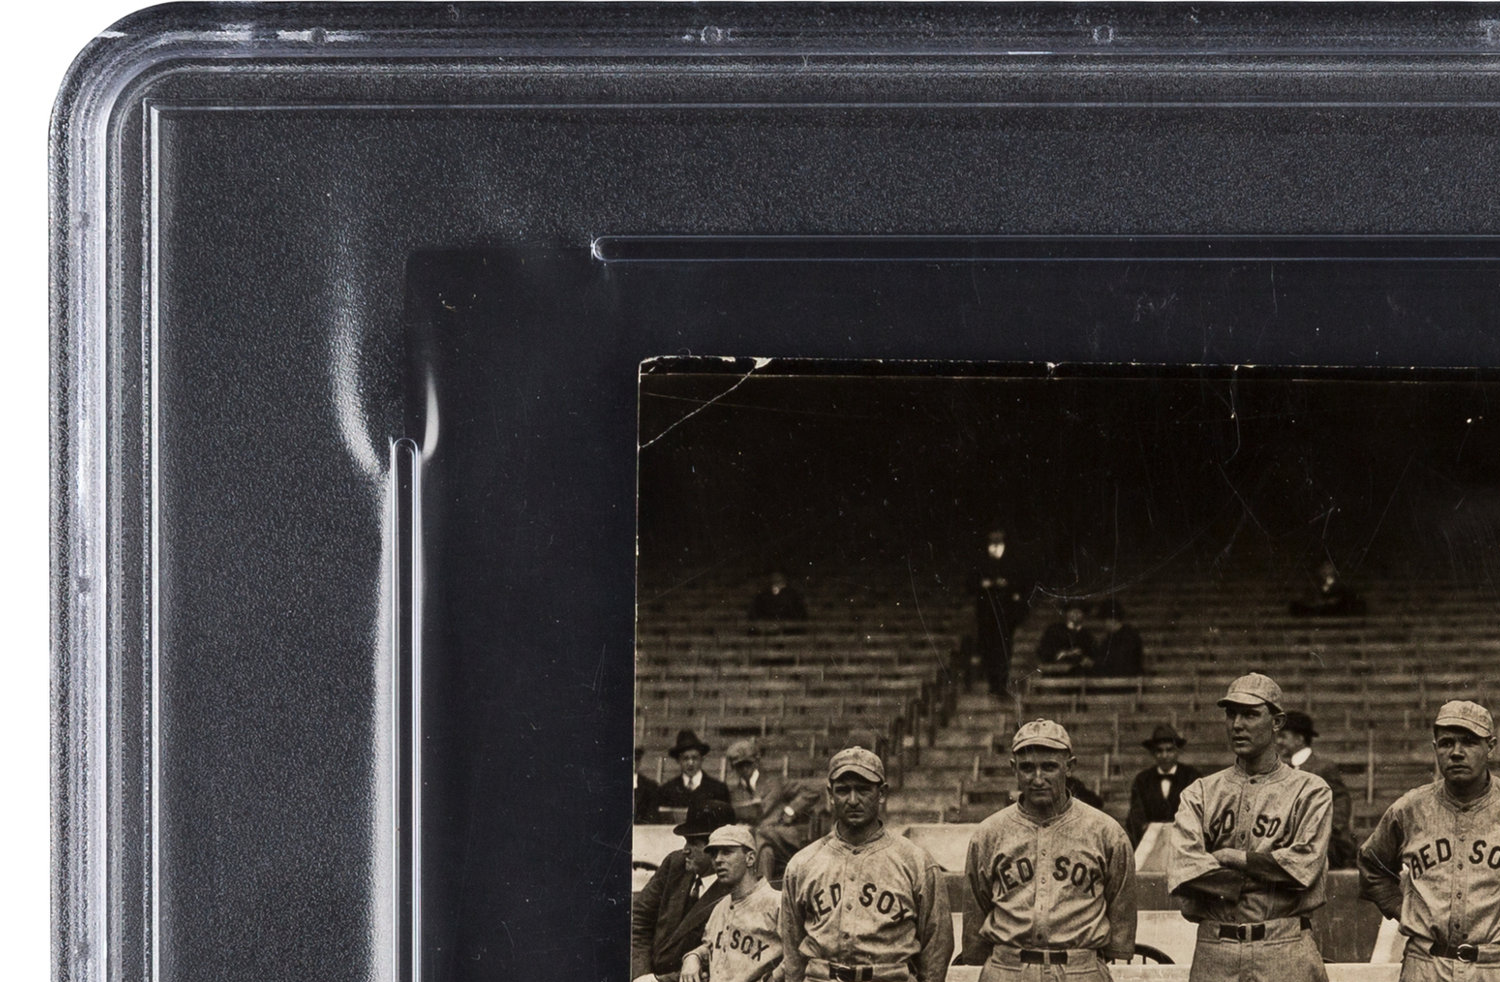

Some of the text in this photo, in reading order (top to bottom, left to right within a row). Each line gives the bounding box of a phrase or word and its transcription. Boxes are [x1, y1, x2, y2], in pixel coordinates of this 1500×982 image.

[1052, 856, 1105, 899] SOX
[858, 882, 910, 921] SOX
[729, 929, 770, 962] SOX
